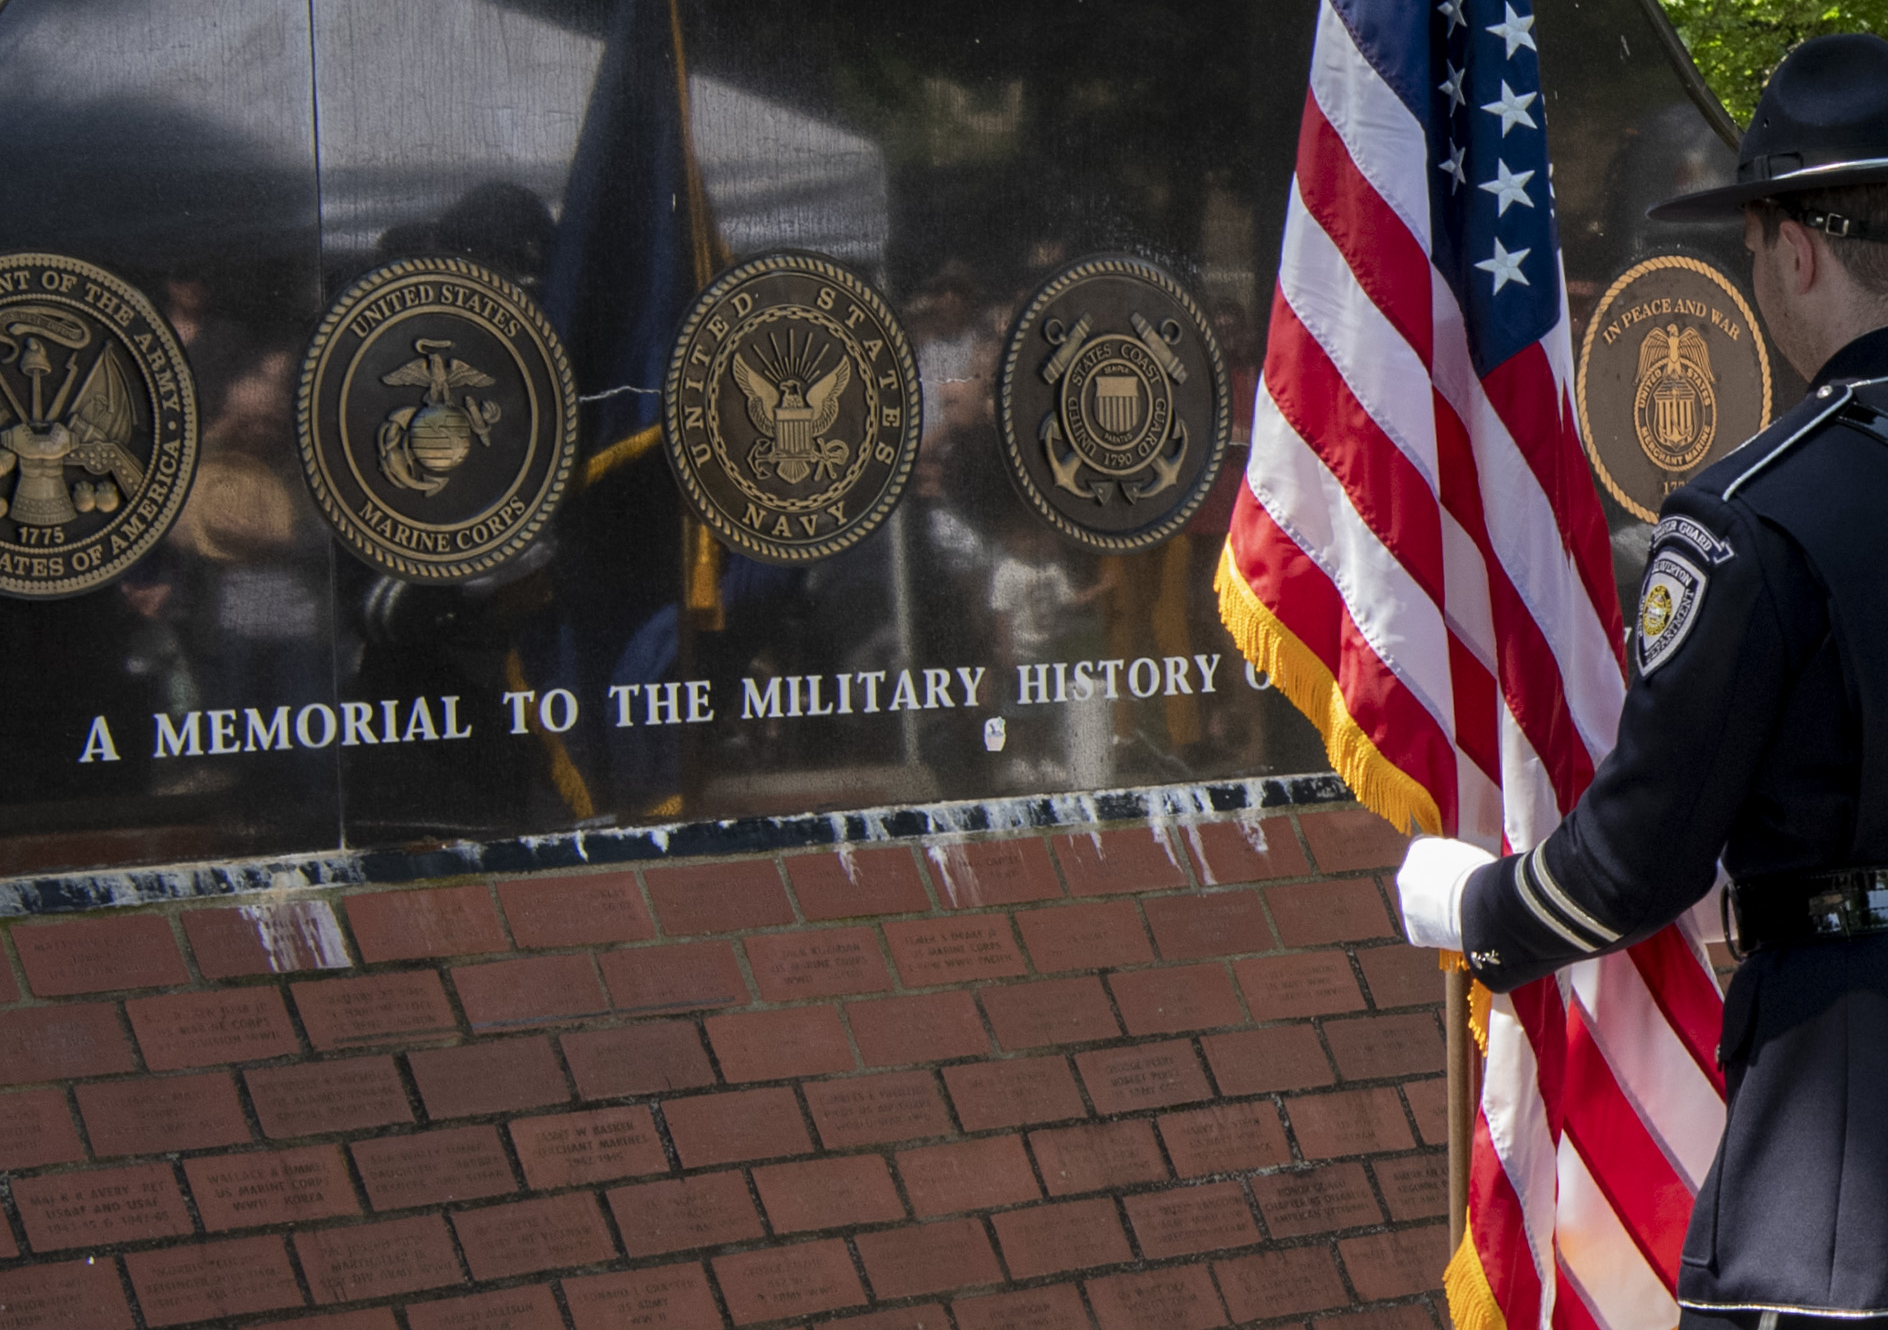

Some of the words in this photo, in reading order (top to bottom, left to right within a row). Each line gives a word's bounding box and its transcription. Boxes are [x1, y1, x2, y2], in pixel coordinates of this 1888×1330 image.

[350, 285, 434, 340] UNITED
[440, 285, 521, 338] STATES
[1602, 322, 1621, 345] IN
[1621, 298, 1671, 329] PEACE
[1674, 298, 1706, 318] AND
[1711, 308, 1741, 341] WAR
[41, 271, 77, 292] OF
[85, 282, 135, 327] THE
[134, 331, 181, 412] ARMY
[1121, 343, 1161, 384] COAST
[684, 292, 752, 468] UNITED
[816, 287, 901, 465] STATES
[1072, 343, 1112, 387] STATES
[1639, 369, 1662, 408] UNITED
[1687, 369, 1711, 406] STATES
[1067, 397, 1097, 457] UNITED
[1138, 398, 1166, 457] GUARD
[1641, 425, 1683, 465] MERCHANT
[1685, 425, 1712, 465] MARINE
[1104, 453, 1132, 466] 1790
[71, 545, 103, 571] OF
[110, 438, 181, 555] AMERICA
[359, 500, 450, 553] MARINE
[455, 495, 527, 550] CORPS
[742, 501, 848, 537] NAVY
[19, 526, 65, 545] 1775
[1678, 522, 1713, 552] GUARD
[79, 715, 120, 763] A
[153, 695, 472, 759] MEMORIAL
[502, 687, 579, 736] TO
[609, 679, 714, 728] THE
[740, 666, 986, 720] MILITARY
[1017, 654, 1222, 705] HISTORY
[593, 1121, 635, 1136] BASKER
[238, 1181, 285, 1197] MARINE
